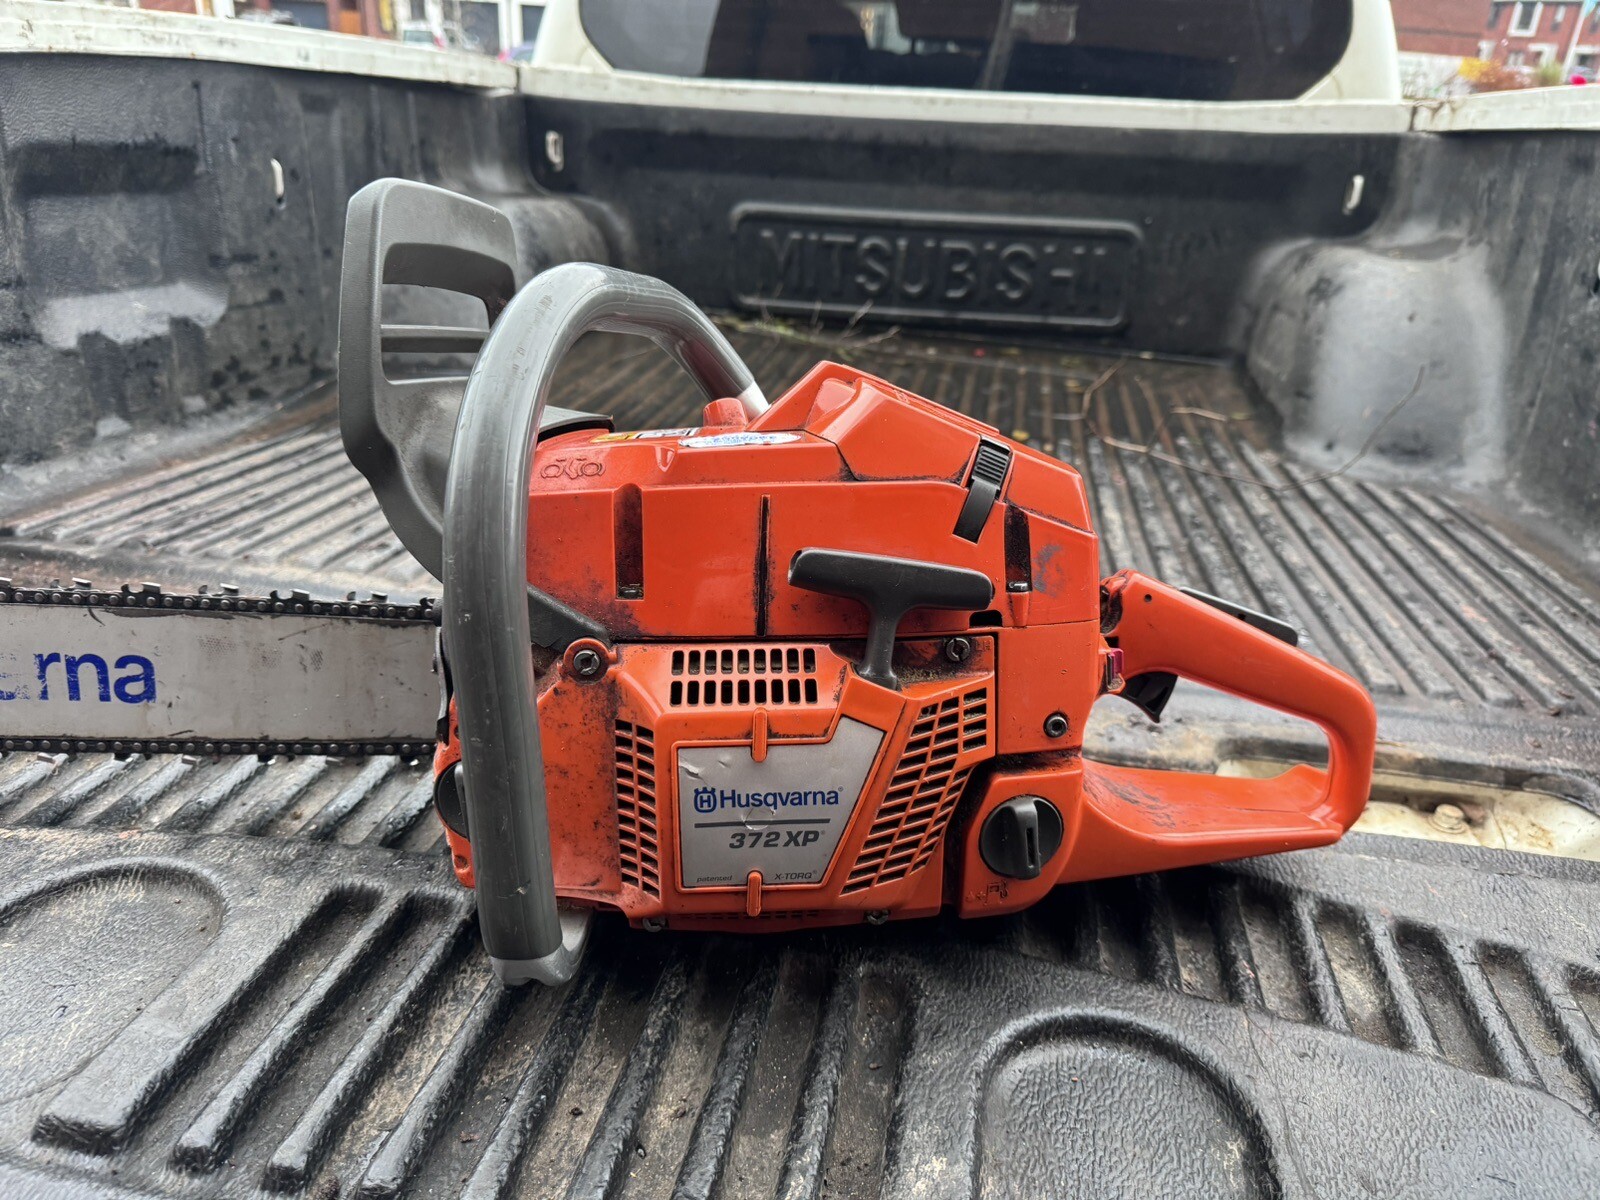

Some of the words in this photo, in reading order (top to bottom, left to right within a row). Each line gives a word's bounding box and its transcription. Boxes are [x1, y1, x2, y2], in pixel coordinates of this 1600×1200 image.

[0, 652, 157, 704] rna
[720, 788, 839, 810] Husqvarna
[696, 875, 733, 883] patented
[774, 872, 813, 881] X-TORQ
